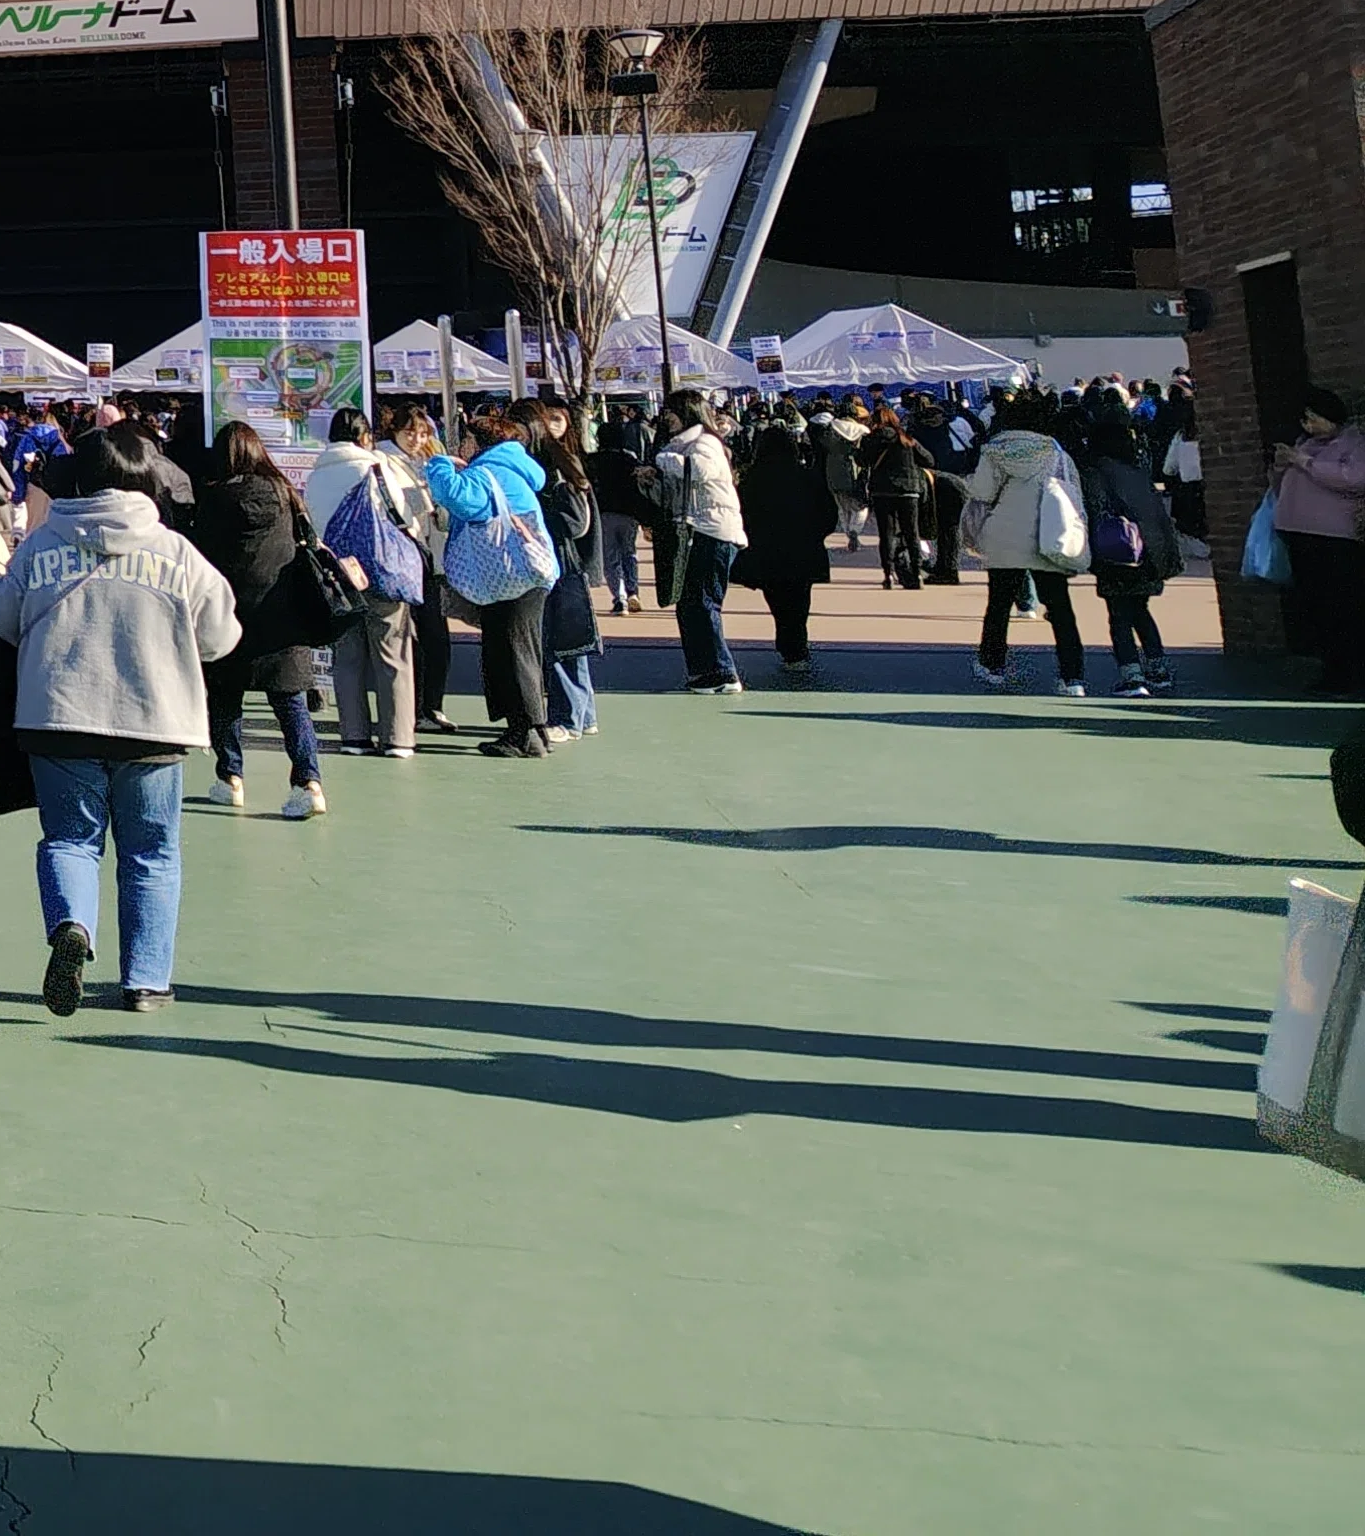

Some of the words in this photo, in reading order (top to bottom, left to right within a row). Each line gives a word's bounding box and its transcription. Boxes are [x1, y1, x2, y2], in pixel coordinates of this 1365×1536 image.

[210, 237, 353, 265] 一般入場口
